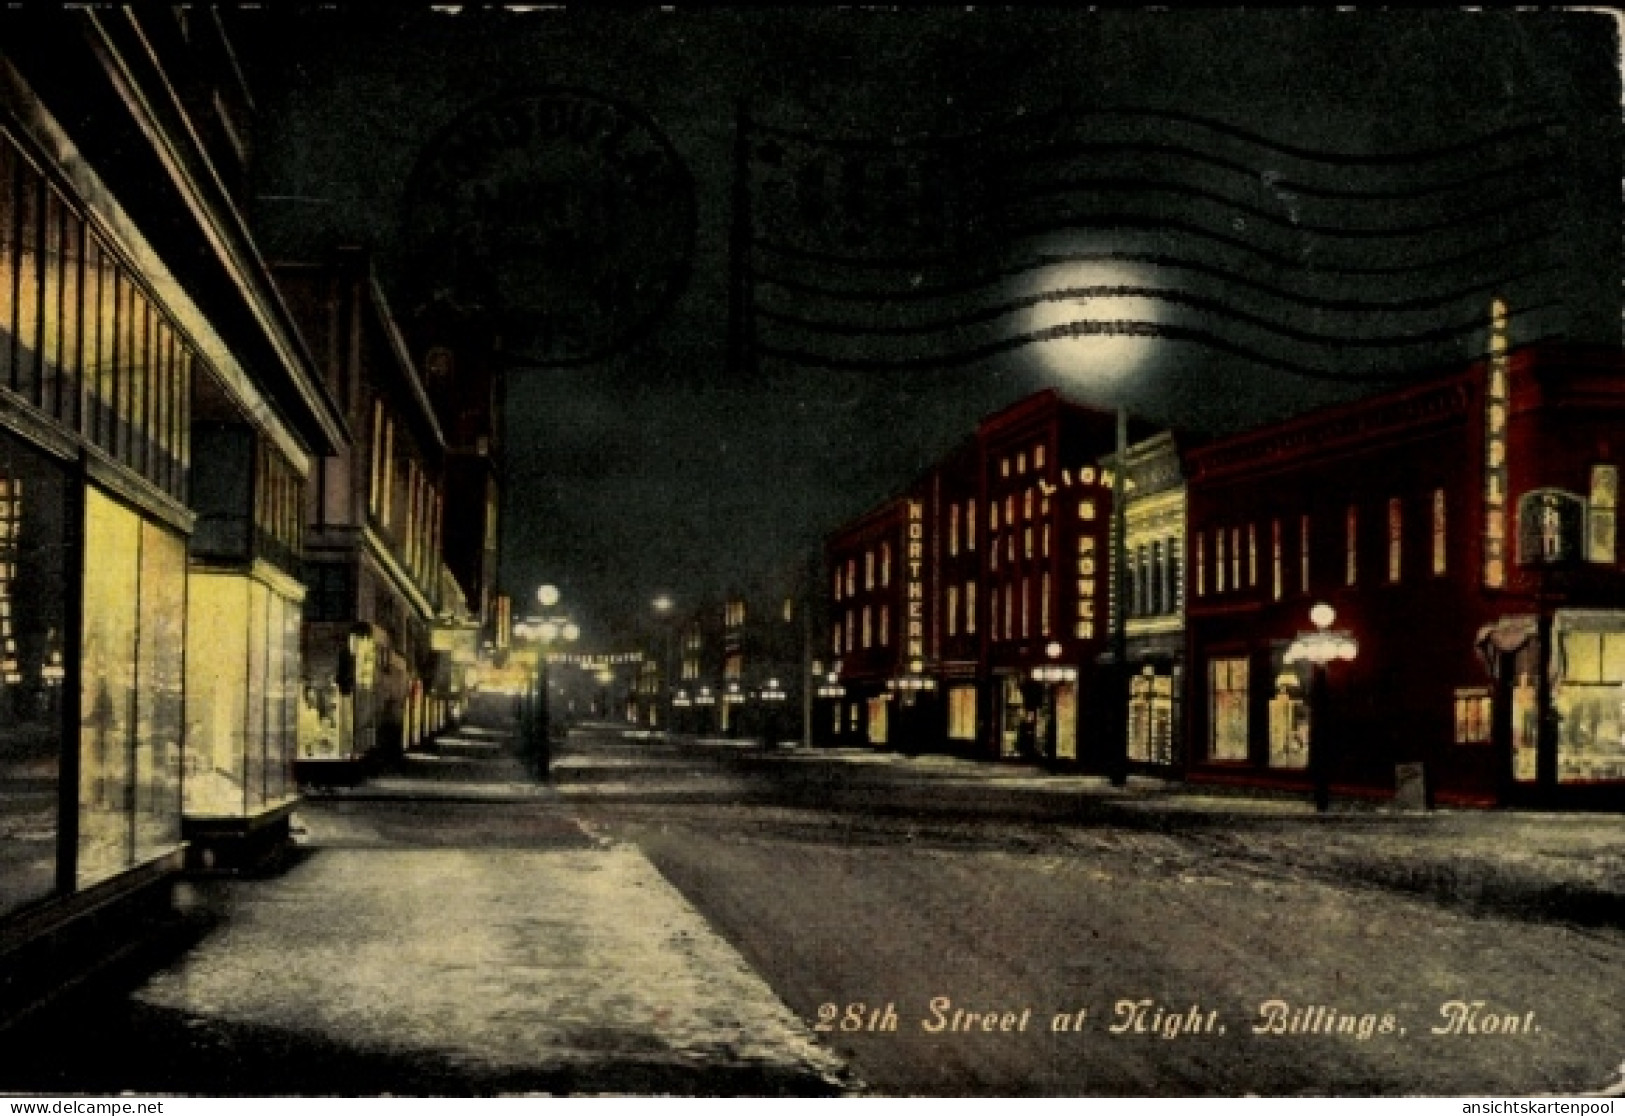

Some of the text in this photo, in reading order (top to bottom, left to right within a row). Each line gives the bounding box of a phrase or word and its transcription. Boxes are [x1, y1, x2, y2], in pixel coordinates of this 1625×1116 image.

[908, 502, 923, 656] NORTHERN
[814, 996, 1541, 1040] 28th Street at Night, Billings, Mont.
